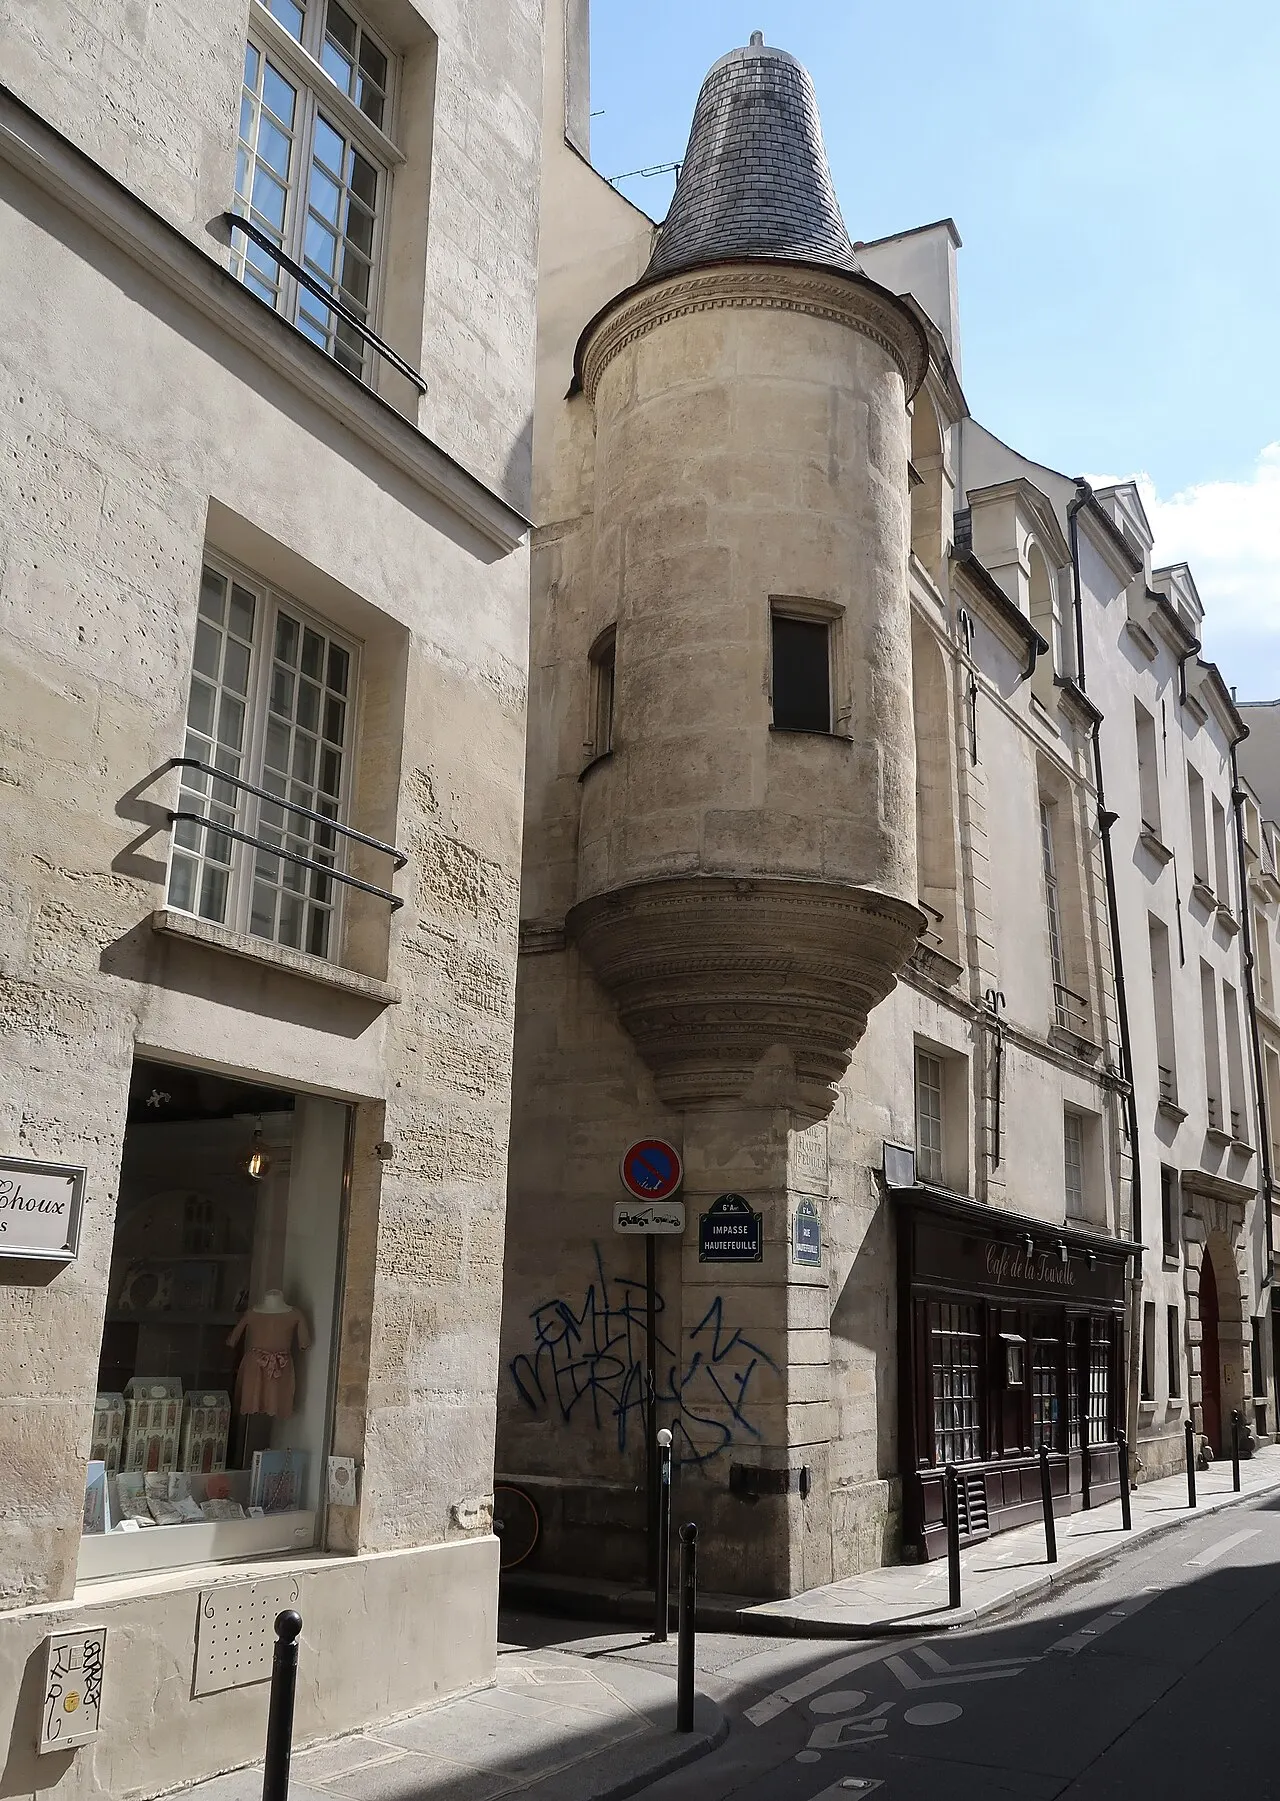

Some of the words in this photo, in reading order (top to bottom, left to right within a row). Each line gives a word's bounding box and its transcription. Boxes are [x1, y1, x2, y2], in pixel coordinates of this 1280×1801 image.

[713, 1225, 748, 1235] IMPASSE
[803, 1228, 811, 1238] RUE
[704, 1241, 757, 1250] HAUTEFEUILLE
[985, 1242, 1010, 1284] Café
[1010, 1249, 1023, 1278] de
[1024, 1256, 1035, 1280] la
[1036, 1253, 1076, 1286] Tourelle
